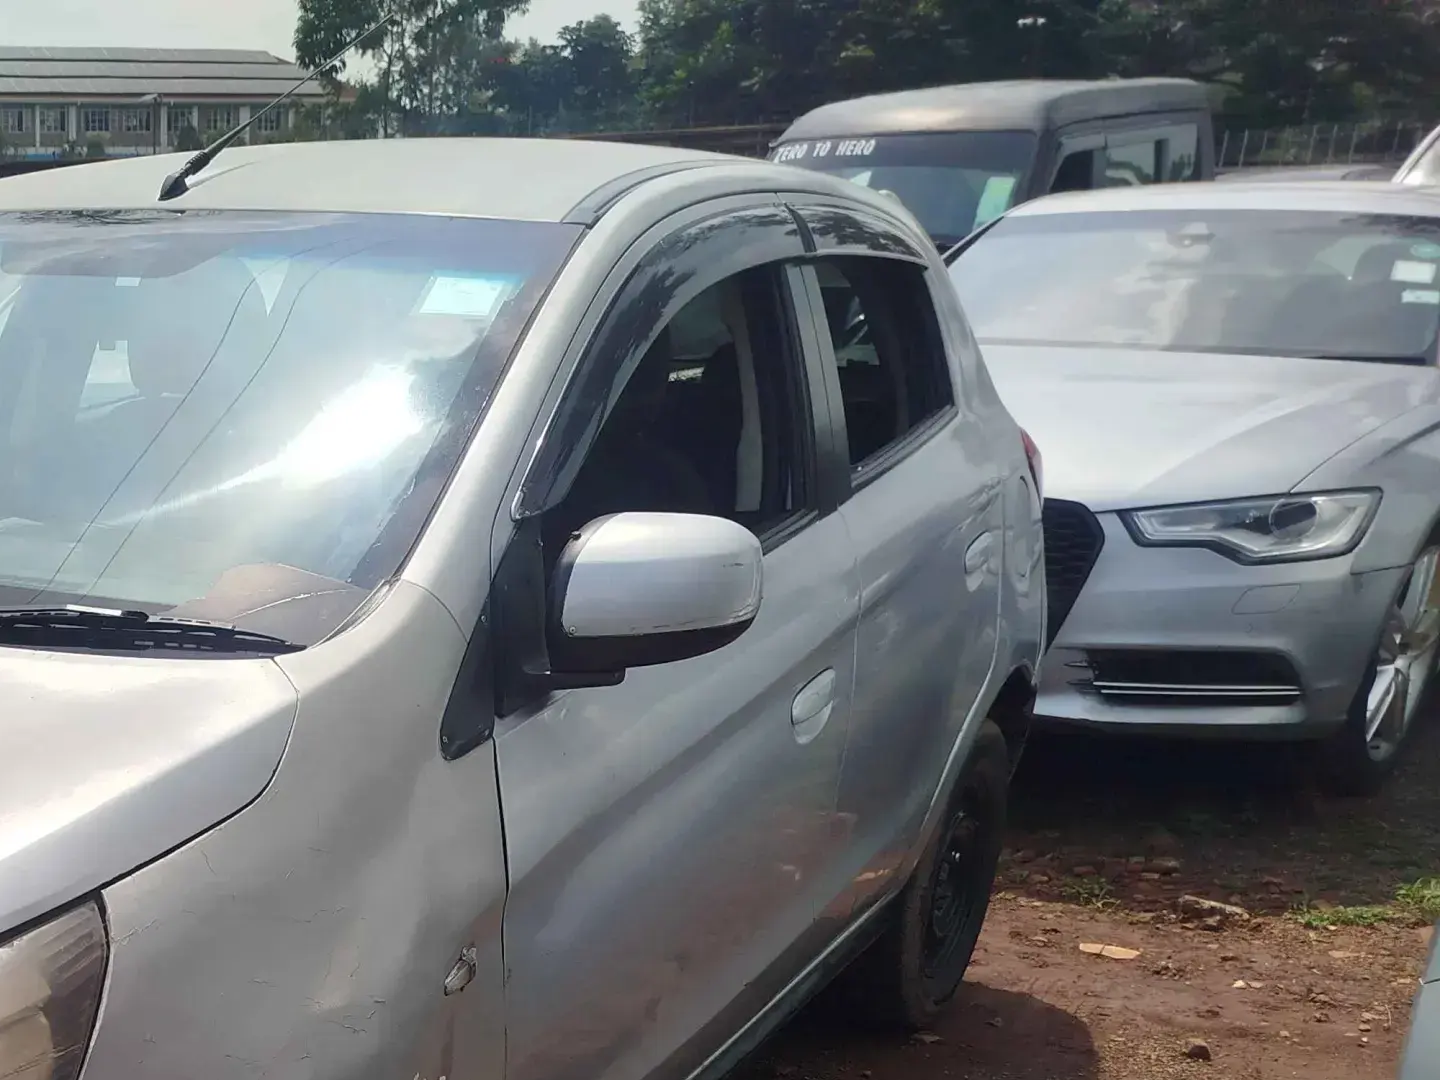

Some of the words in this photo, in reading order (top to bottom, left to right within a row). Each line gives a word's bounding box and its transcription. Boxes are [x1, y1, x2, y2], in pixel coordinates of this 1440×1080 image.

[773, 143, 808, 163] ZERO
[813, 141, 832, 158] TO
[835, 138, 876, 156] HERO
